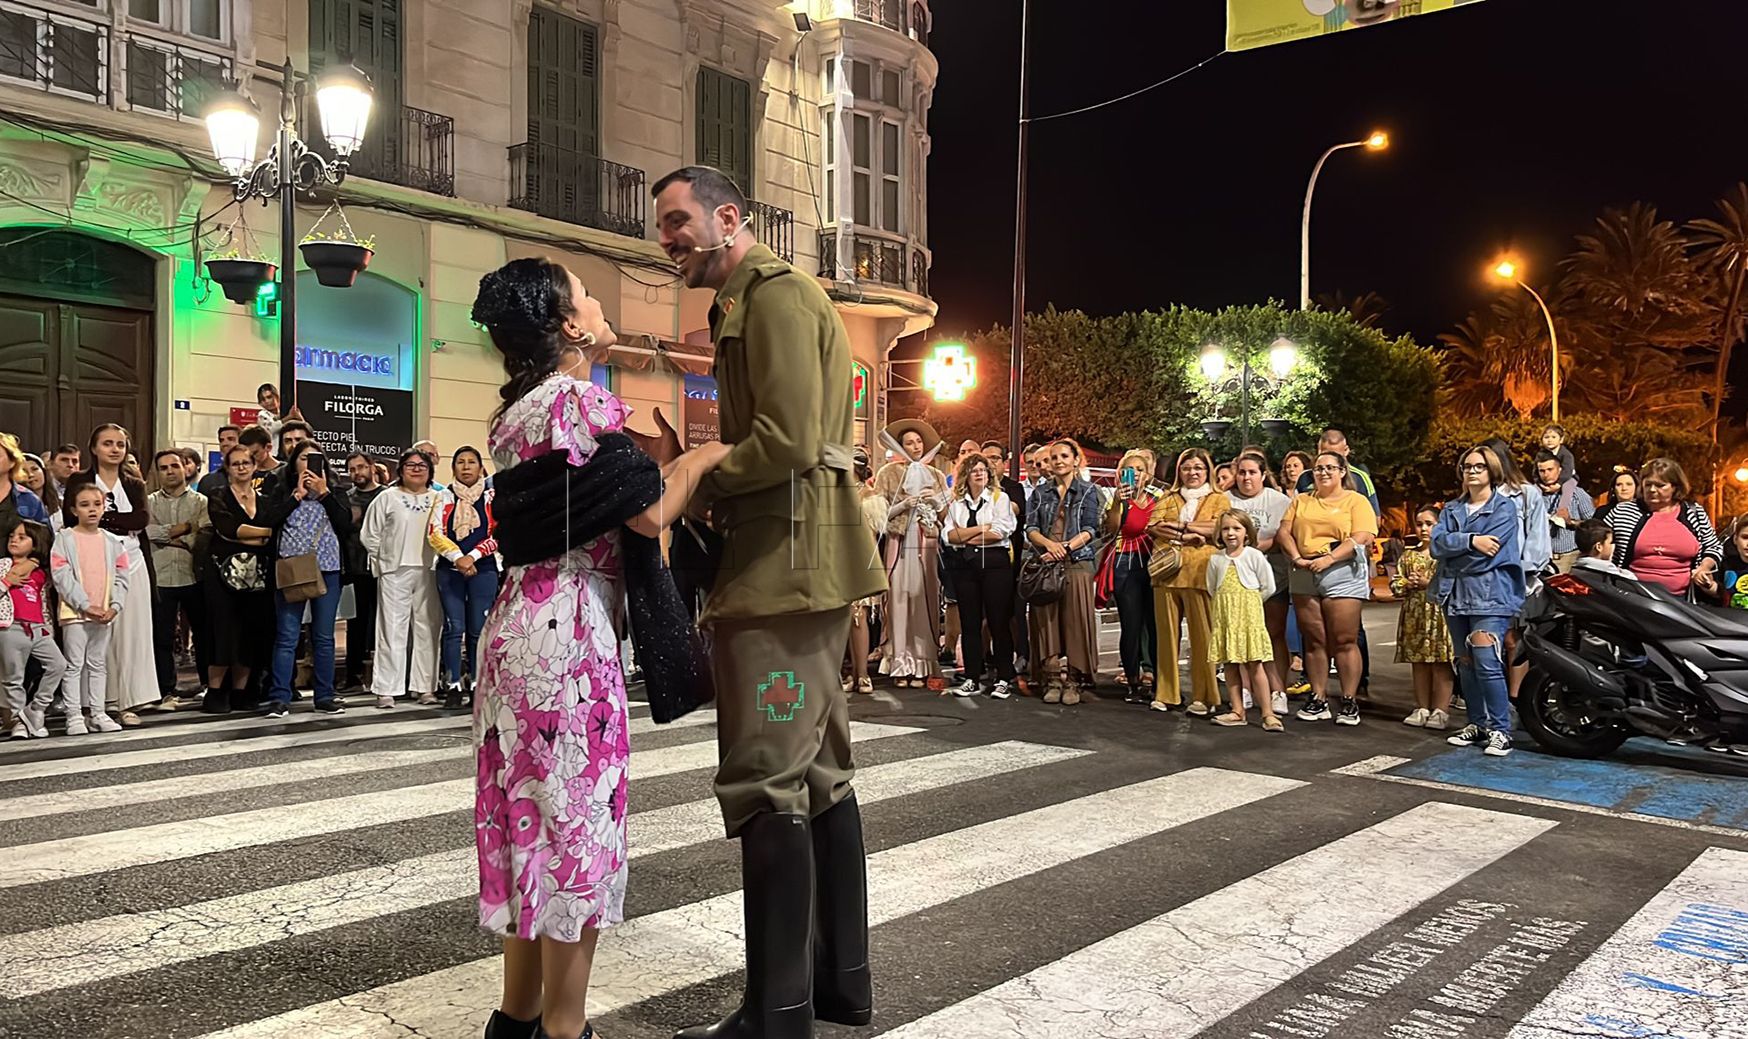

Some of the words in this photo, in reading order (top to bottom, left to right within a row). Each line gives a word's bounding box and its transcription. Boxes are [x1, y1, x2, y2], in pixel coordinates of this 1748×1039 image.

[295, 346, 393, 375] armacia
[324, 400, 384, 416] FILORGA
[313, 430, 339, 441] FECTO
[320, 441, 347, 452] FECTA
[365, 444, 397, 455] TRUCOS
